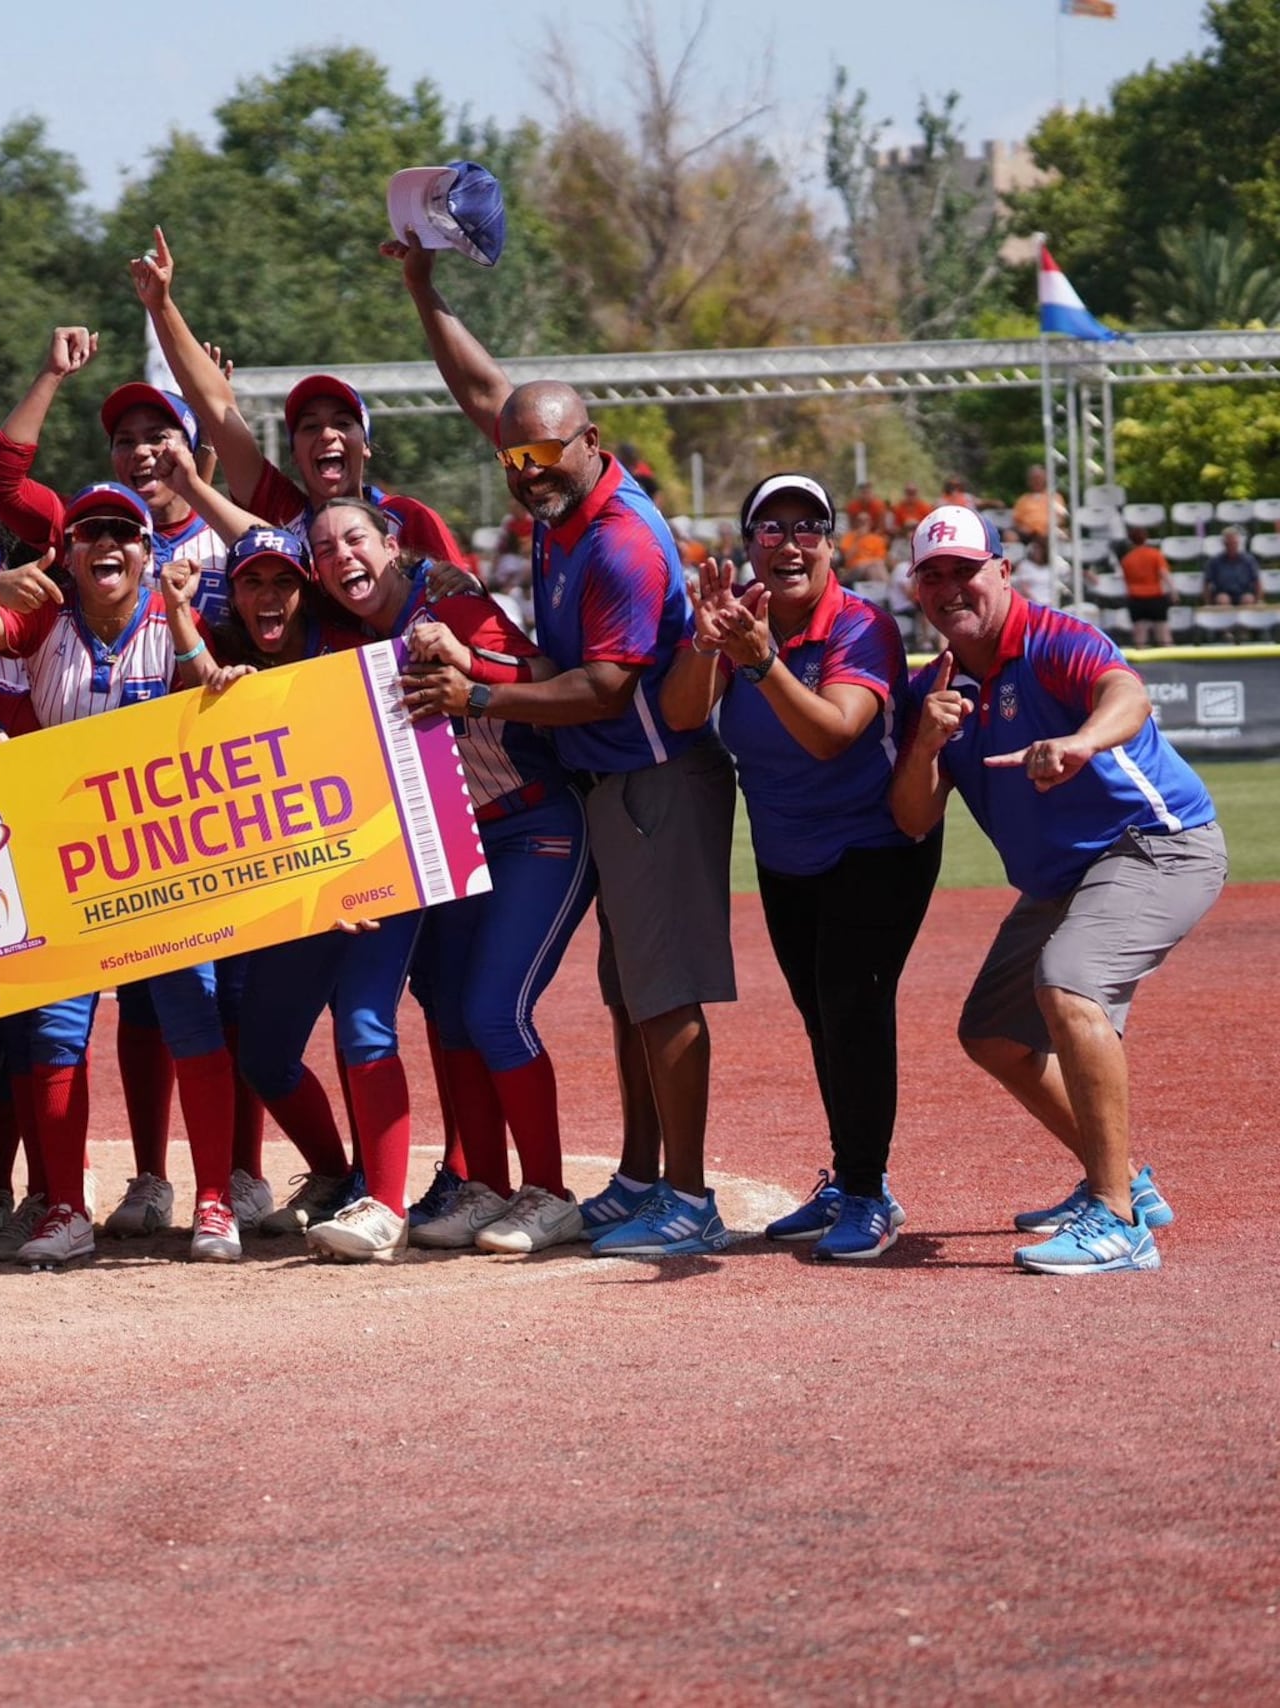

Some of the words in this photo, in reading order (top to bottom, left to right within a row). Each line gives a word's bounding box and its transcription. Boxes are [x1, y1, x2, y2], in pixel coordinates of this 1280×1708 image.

[84, 726, 291, 823] TICKET
[57, 775, 354, 895] PUNCHED
[82, 881, 185, 925] HEADING
[187, 873, 219, 897] TO
[222, 860, 269, 888] THE
[271, 839, 353, 876] FINALS
[341, 884, 396, 911] @WBSC
[100, 925, 235, 972] #SoftballWorldCupW
